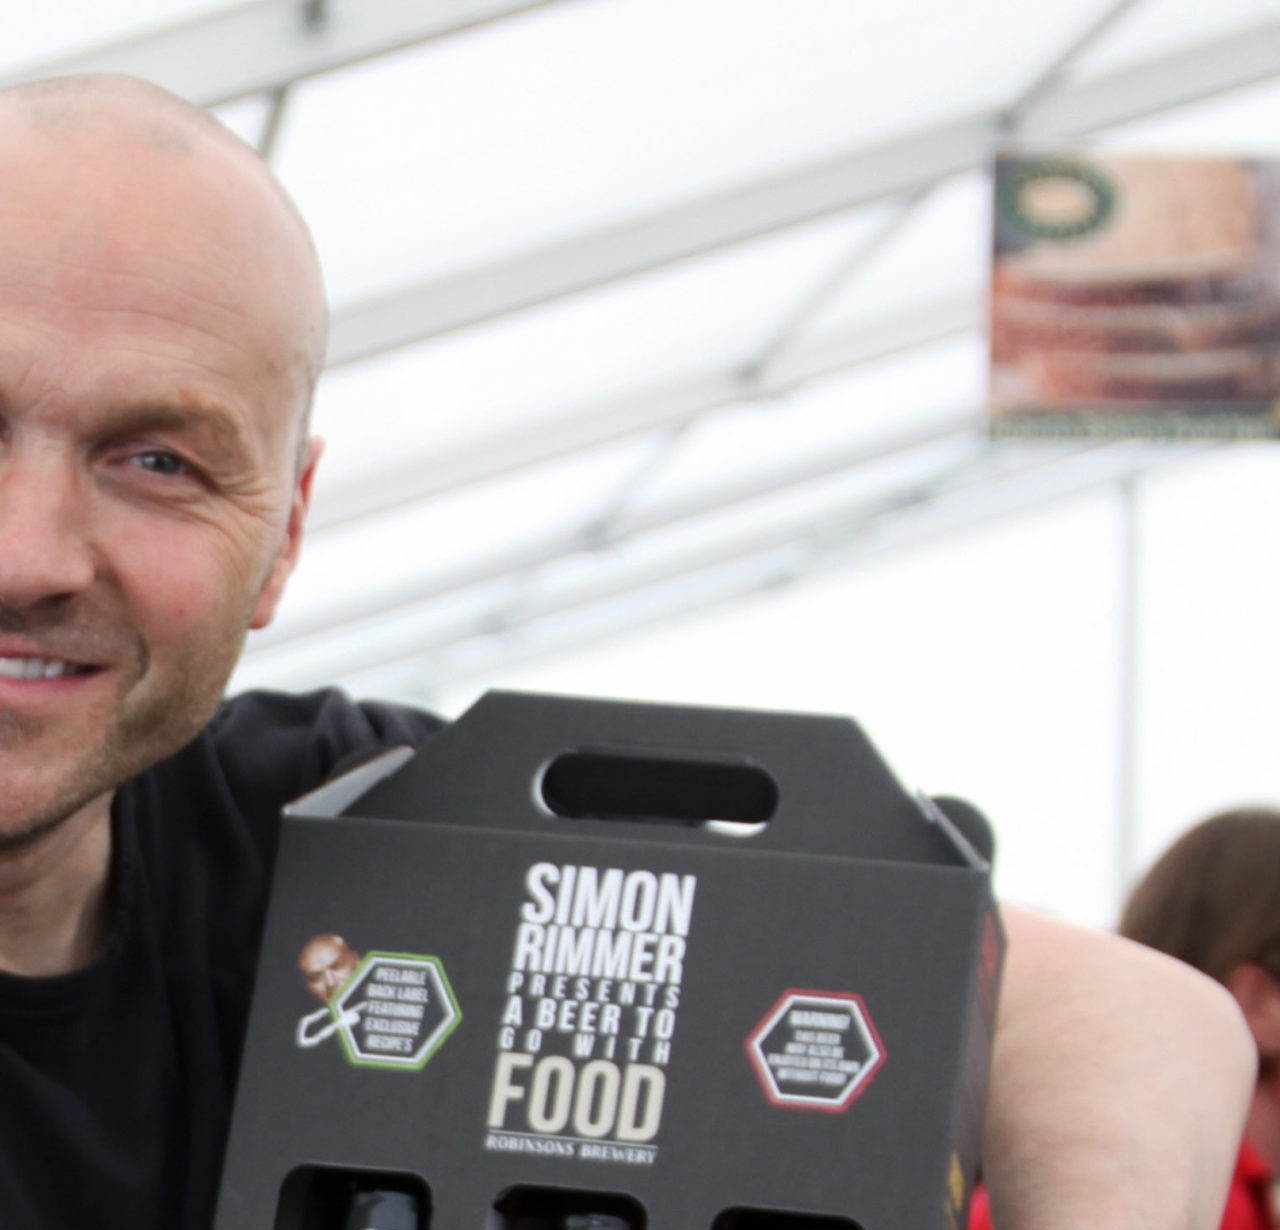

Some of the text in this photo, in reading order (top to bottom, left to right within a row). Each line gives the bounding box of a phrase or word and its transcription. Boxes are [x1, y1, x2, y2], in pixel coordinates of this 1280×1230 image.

[521, 862, 697, 936] SIMON
[512, 922, 687, 984] RIMMER
[507, 971, 680, 1008] PRESENTS
[503, 995, 675, 1041] A BEER TO
[498, 1026, 671, 1064] GO WITH
[487, 1051, 666, 1142] FOOD
[485, 1133, 659, 1165] ROBINSONS BREWERY
